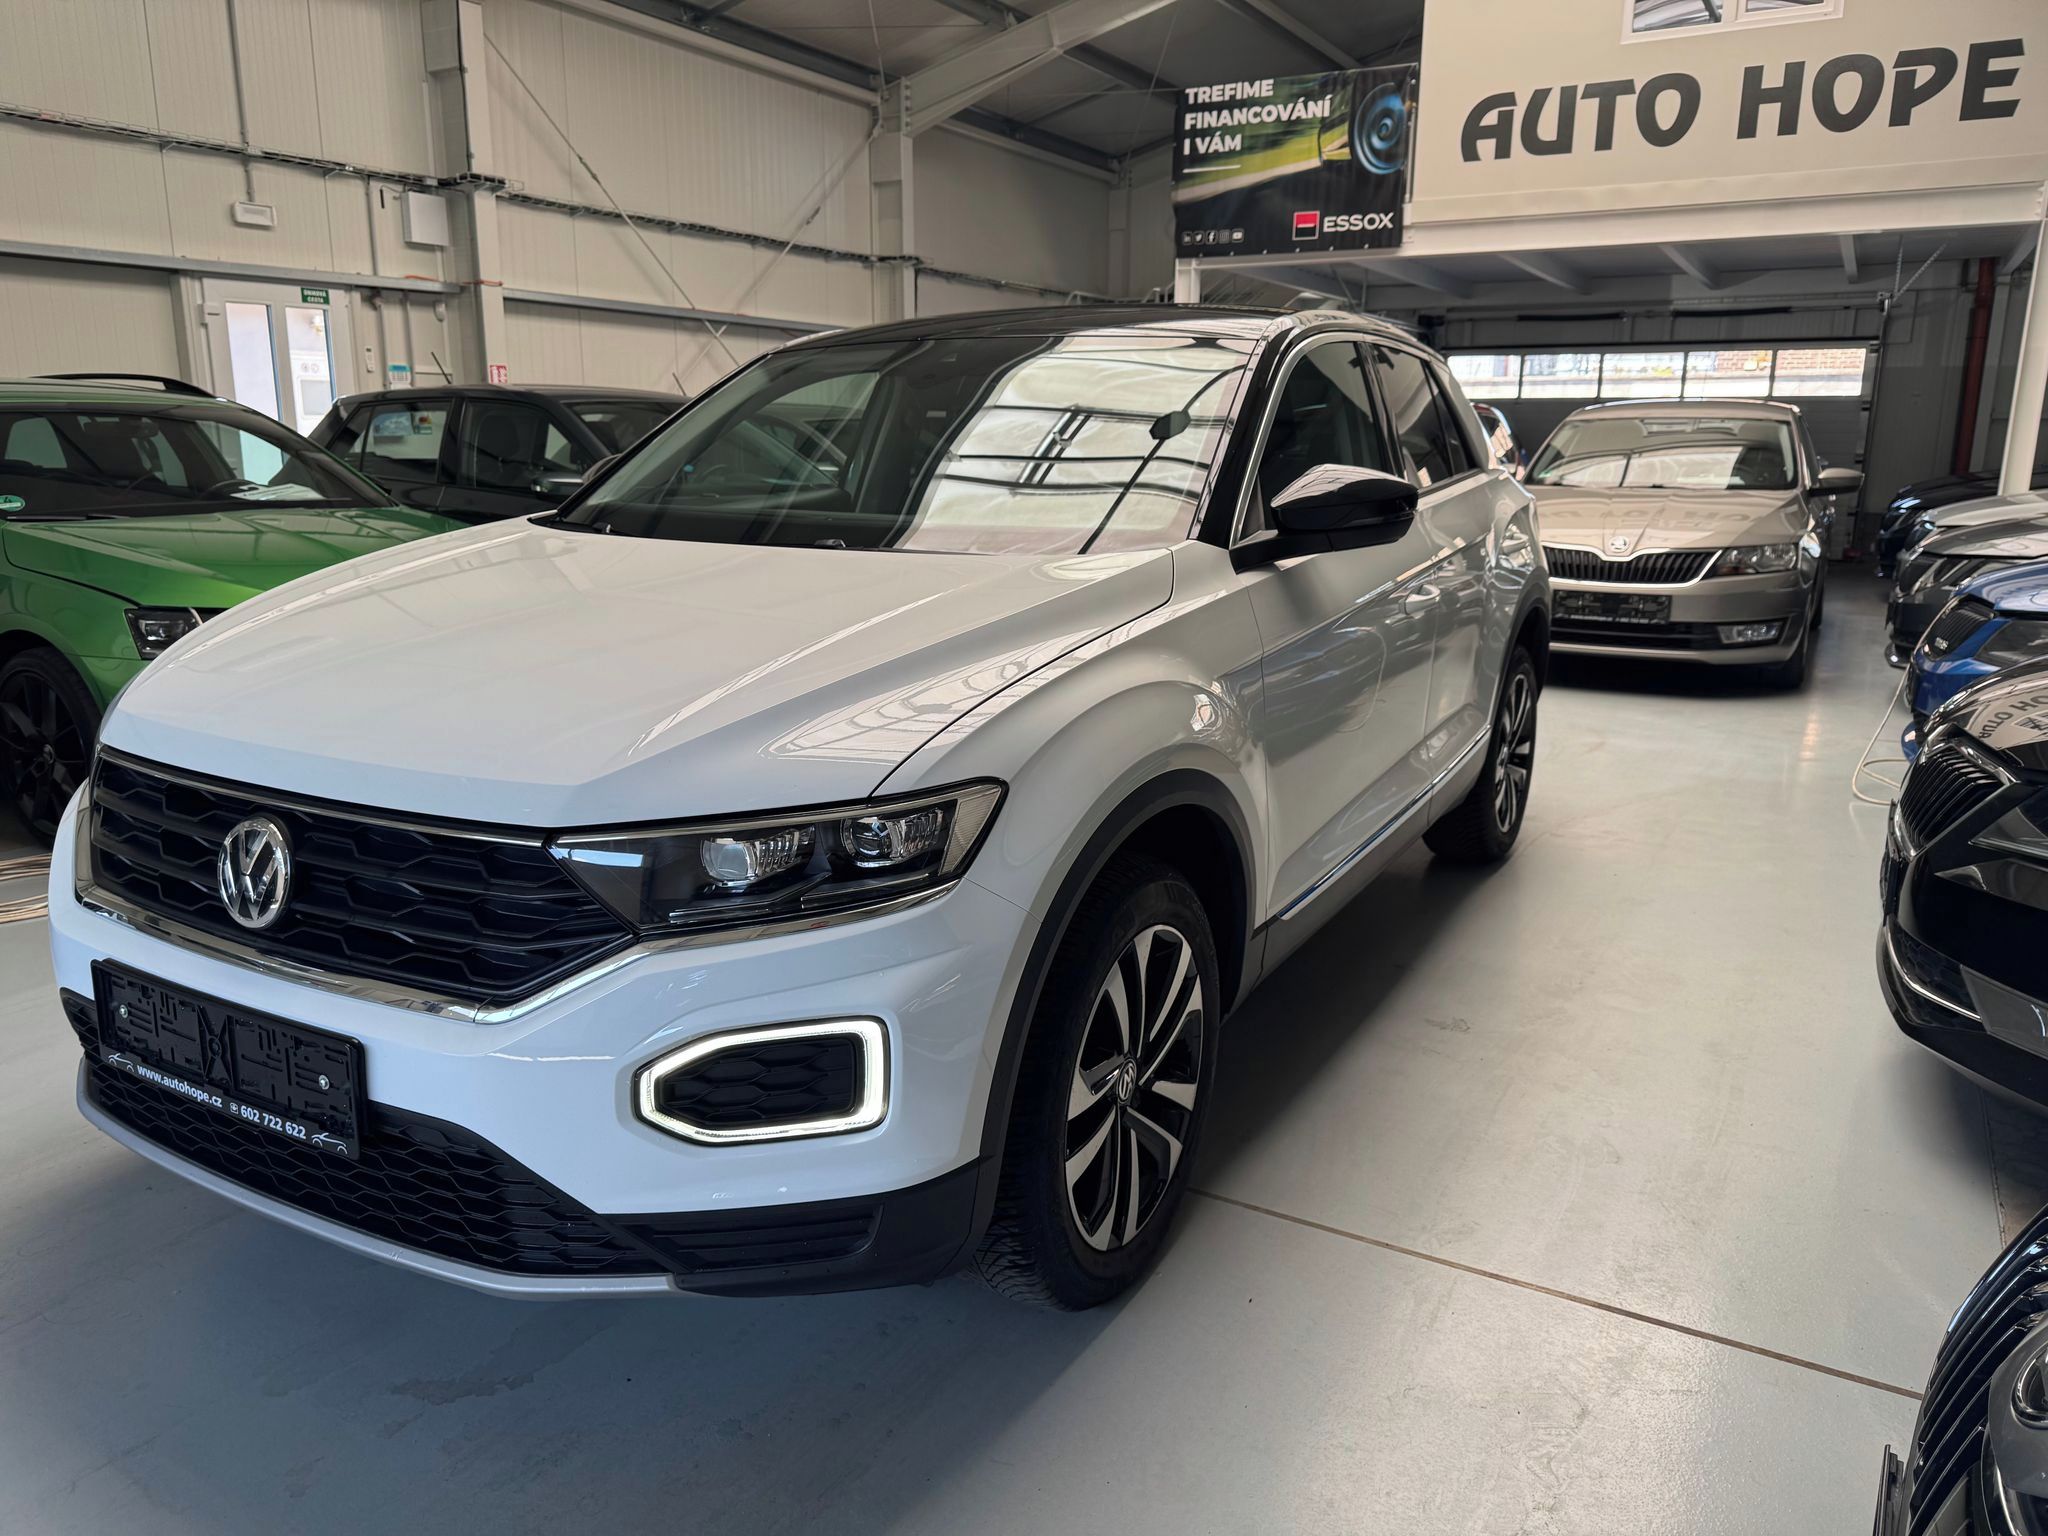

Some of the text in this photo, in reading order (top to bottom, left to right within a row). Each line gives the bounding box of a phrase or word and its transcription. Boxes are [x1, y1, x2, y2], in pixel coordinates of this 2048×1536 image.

[1184, 78, 1274, 105] TREFIME
[1461, 38, 2025, 162] AUTO HOPE
[1183, 94, 1332, 130] FINANCOVÁNÍ
[1183, 133, 1242, 155] I VÁM
[1322, 212, 1395, 233] ESSOX
[137, 1064, 307, 1140] www.autohope.cz 602 722 622
